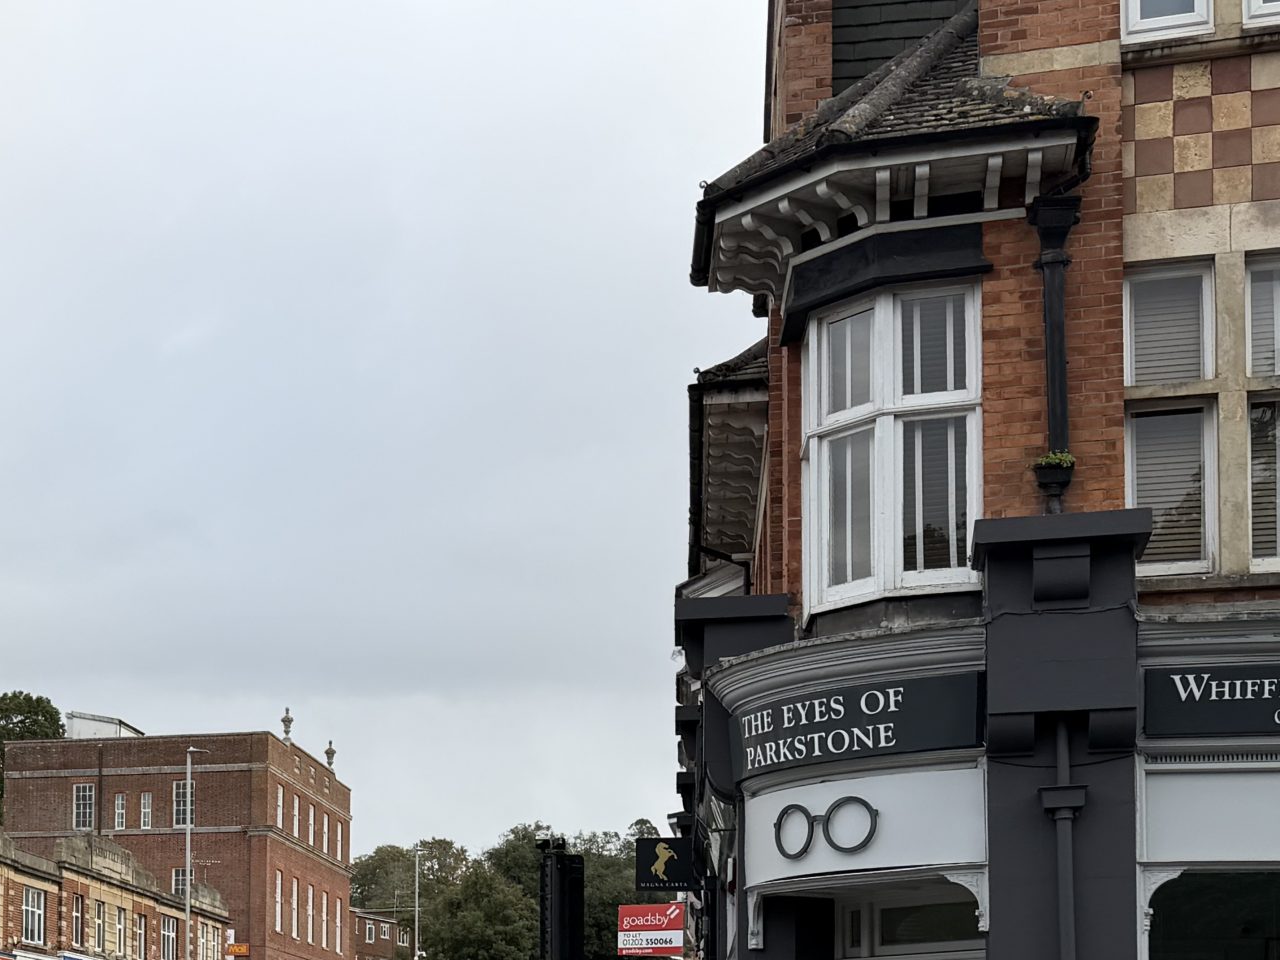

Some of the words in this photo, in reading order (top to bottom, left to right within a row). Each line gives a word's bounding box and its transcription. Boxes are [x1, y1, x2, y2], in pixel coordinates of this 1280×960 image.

[1170, 673, 1280, 702] WHIFF
[742, 709, 774, 739] THE
[781, 696, 845, 729] EYES
[860, 687, 904, 715] OF
[746, 723, 896, 770] PARKSTONE
[623, 912, 670, 929] goadsby
[622, 939, 644, 947] 01202
